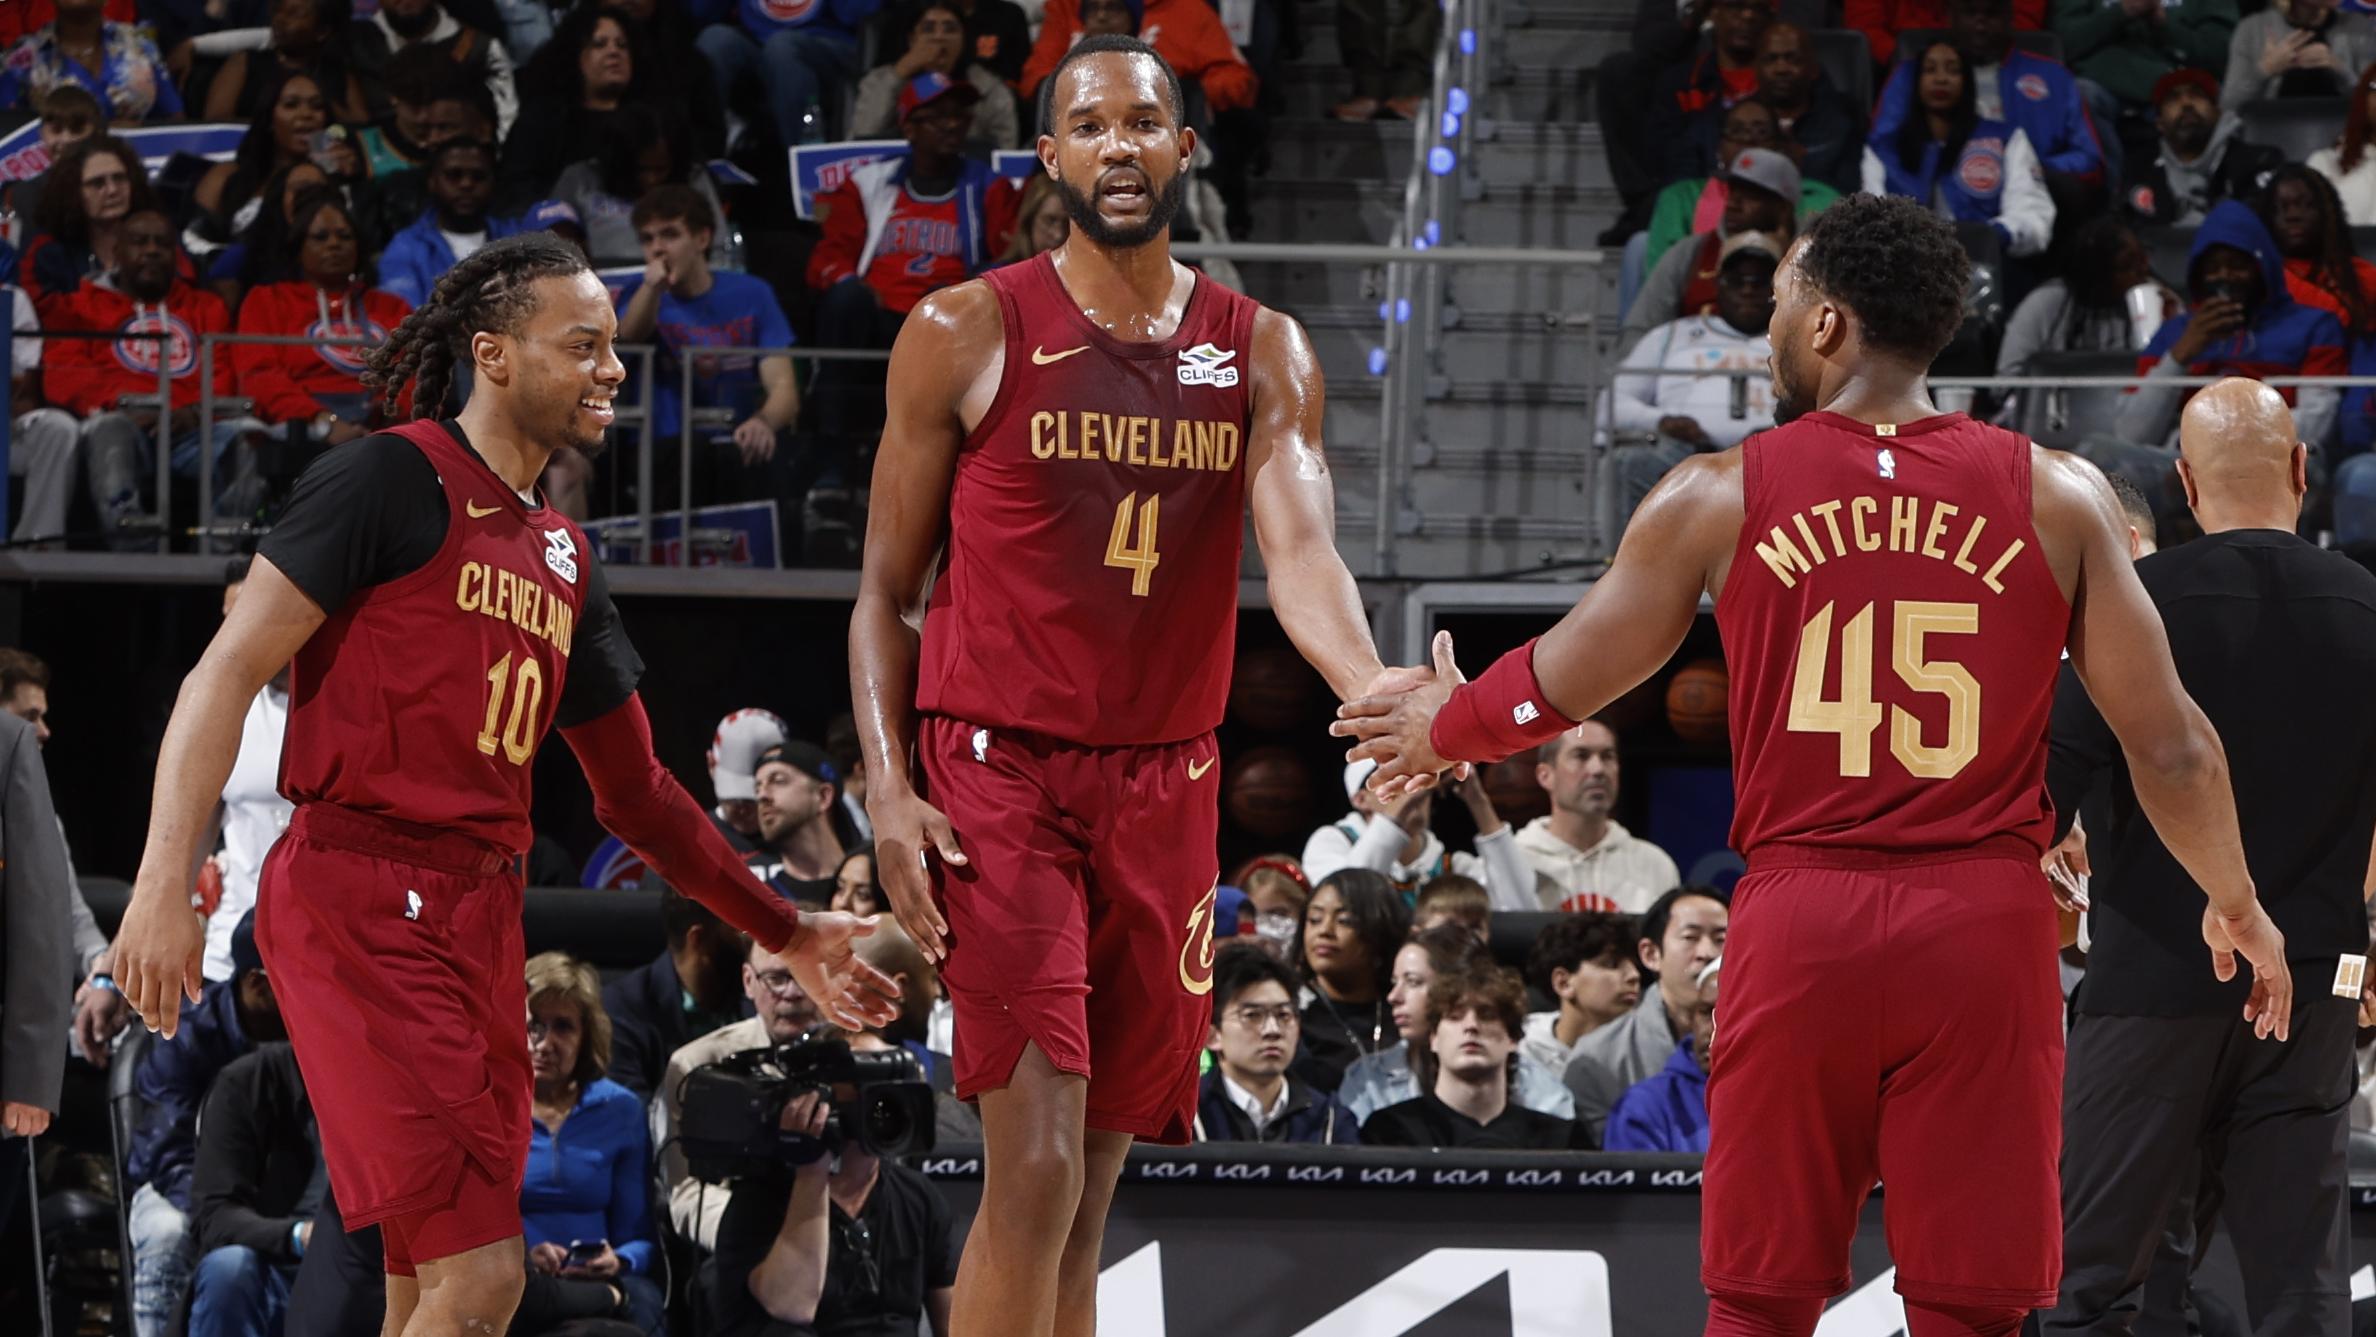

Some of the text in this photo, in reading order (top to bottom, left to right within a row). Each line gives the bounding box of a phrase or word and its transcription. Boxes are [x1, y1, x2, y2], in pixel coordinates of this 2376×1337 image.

[873, 218, 962, 256] DETROI
[904, 252, 936, 276] 2
[1180, 369, 1236, 383] CLIFFS
[1031, 411, 1239, 471] CLEVELAND
[547, 552, 576, 579] CLIFFS
[1104, 490, 1160, 597] 4
[1755, 496, 2025, 595] MITCHELL
[456, 561, 573, 658] CLEVELAND
[477, 650, 542, 766] 10
[1787, 600, 1981, 779] 45
